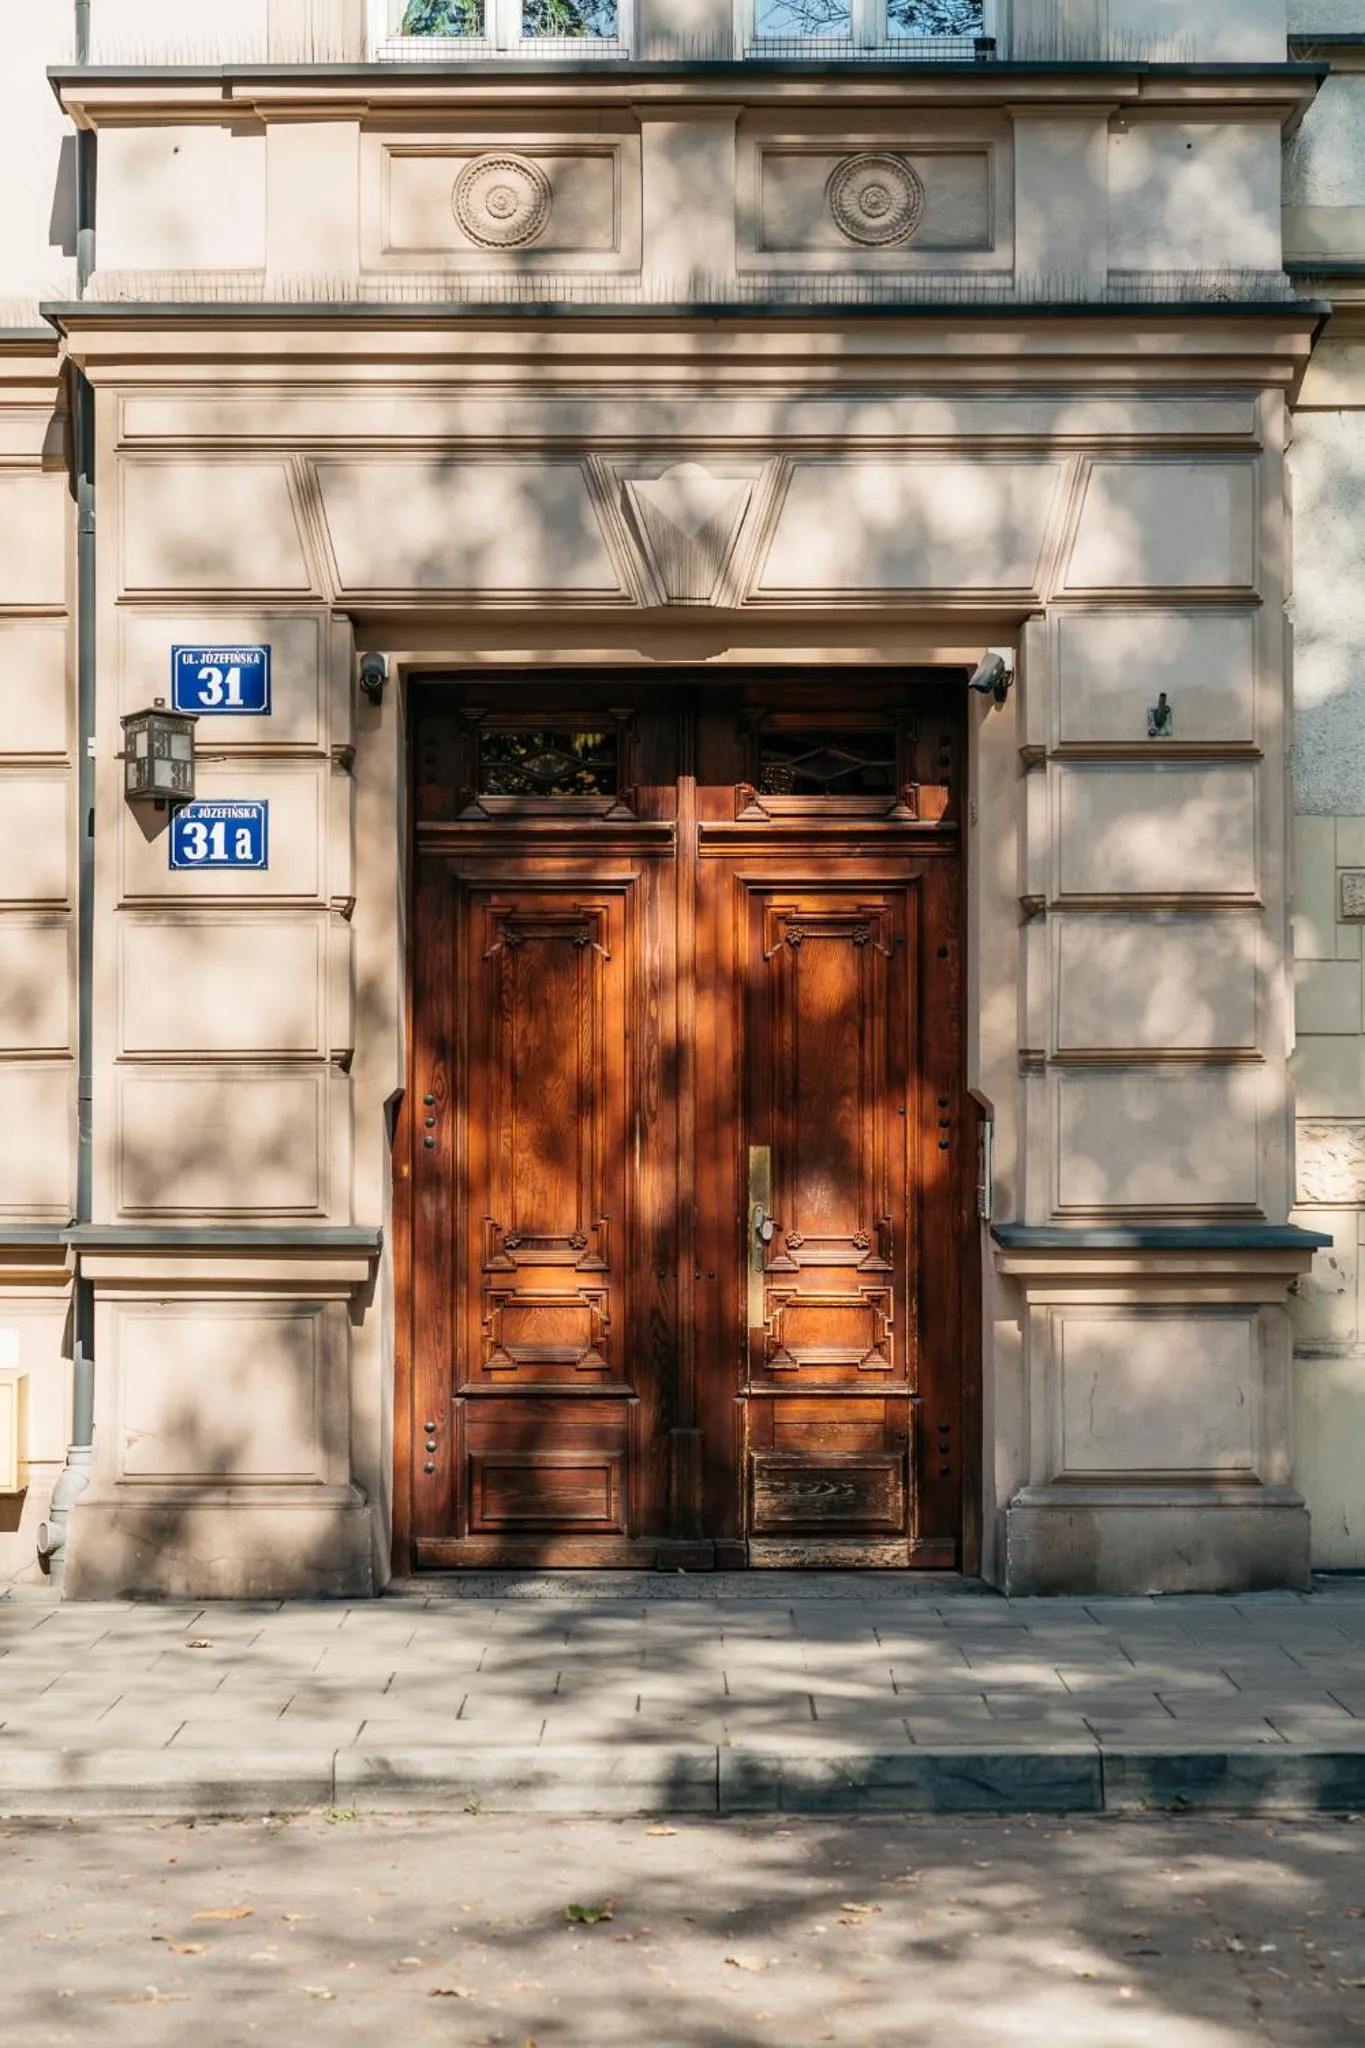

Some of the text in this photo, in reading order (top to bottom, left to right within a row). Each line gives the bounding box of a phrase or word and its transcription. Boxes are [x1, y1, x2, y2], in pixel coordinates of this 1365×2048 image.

[182, 653, 199, 665] UL.
[197, 667, 244, 705] 31
[180, 808, 196, 819] UL.
